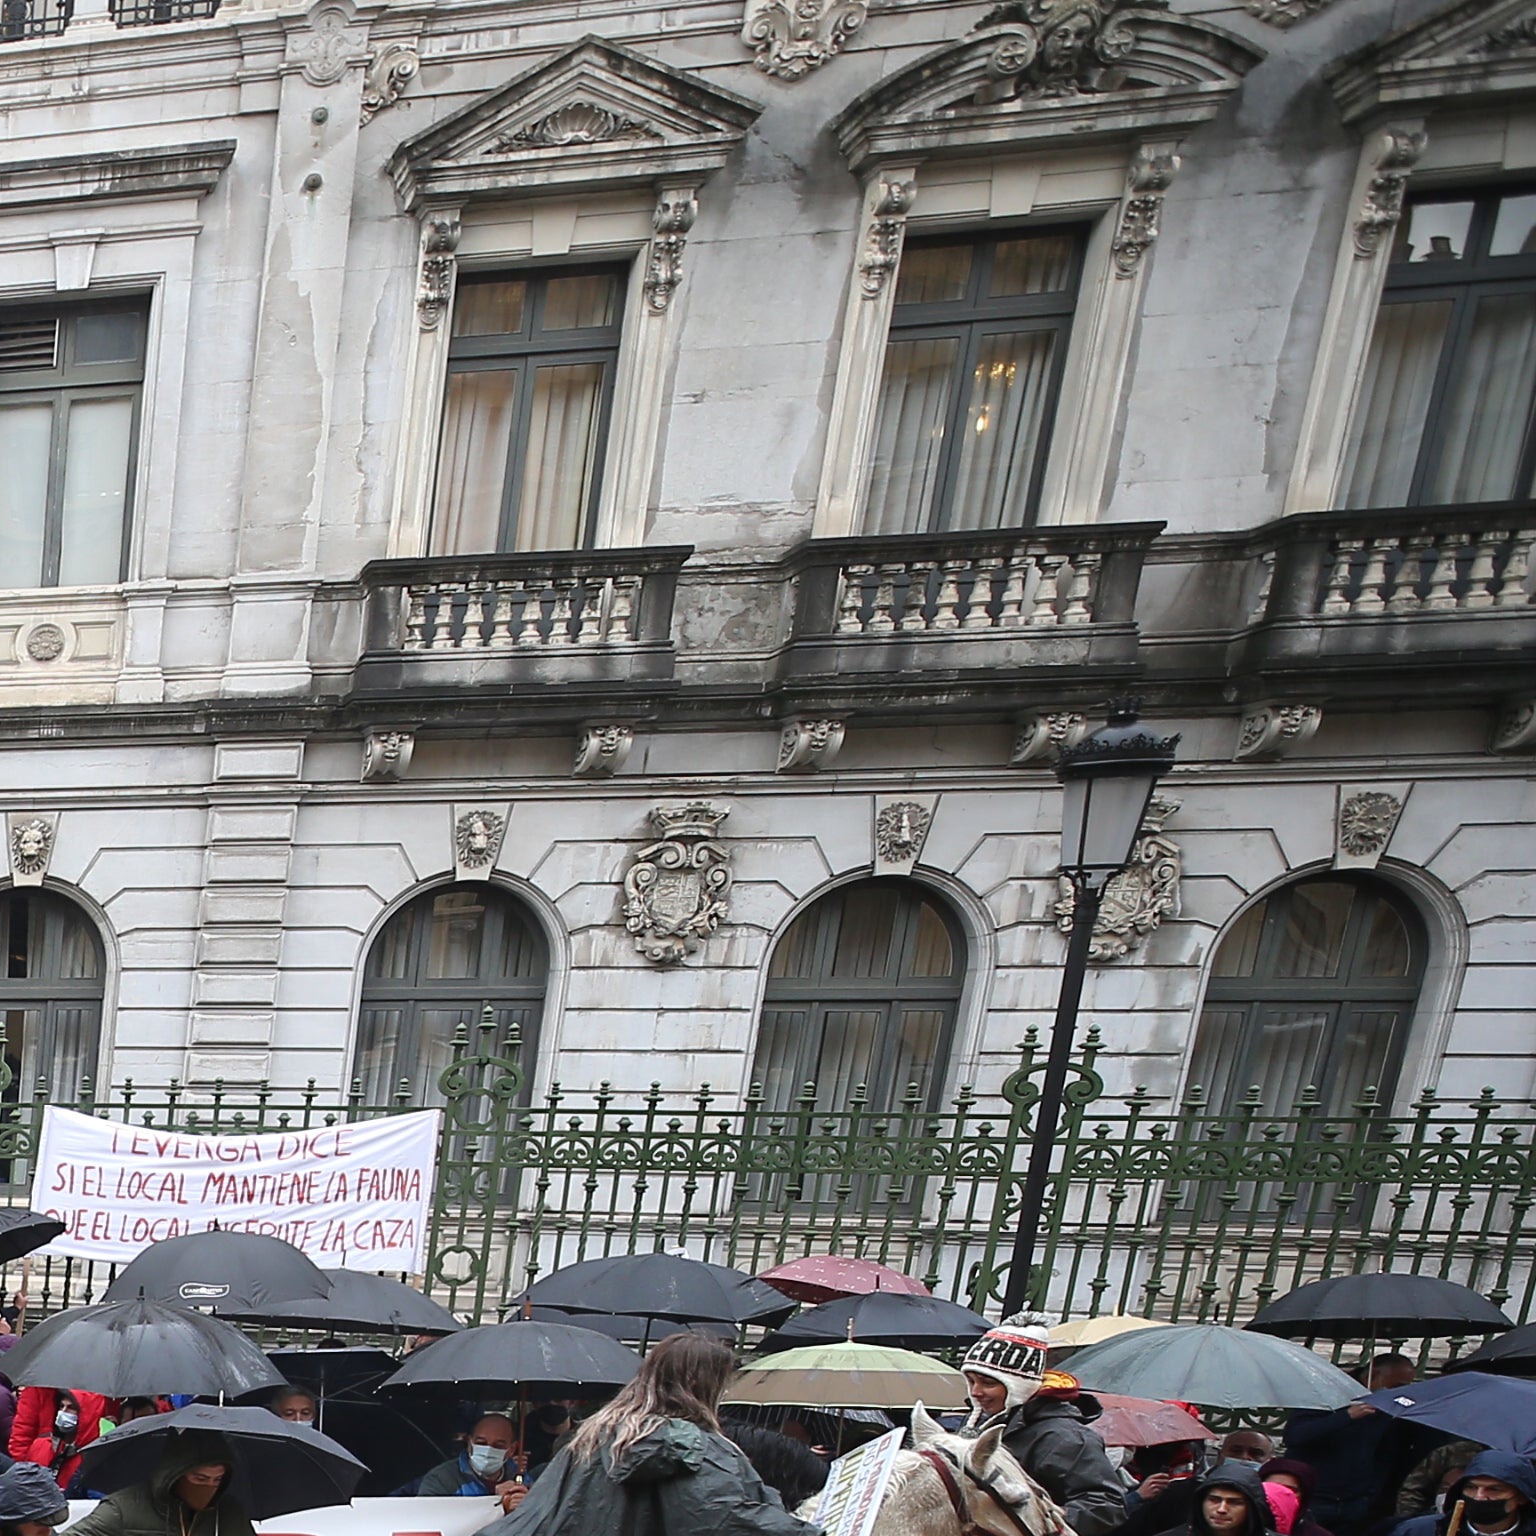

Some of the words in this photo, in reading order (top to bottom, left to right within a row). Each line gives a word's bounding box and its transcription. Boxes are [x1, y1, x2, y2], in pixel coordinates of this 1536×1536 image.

[106, 1125, 262, 1162] TEVERGA
[278, 1129, 354, 1160] DICE
[51, 1162, 75, 1194] SI
[82, 1166, 107, 1198] EL
[115, 1167, 189, 1204] LOCAL
[200, 1171, 322, 1206] MANTIENE
[324, 1171, 347, 1202] LA
[357, 1167, 421, 1202] FAUNA
[91, 1211, 111, 1242] EL
[320, 1219, 346, 1251] LA
[353, 1219, 415, 1250] CAZA
[862, 1443, 878, 1467] NO
[855, 1470, 870, 1488] SE
